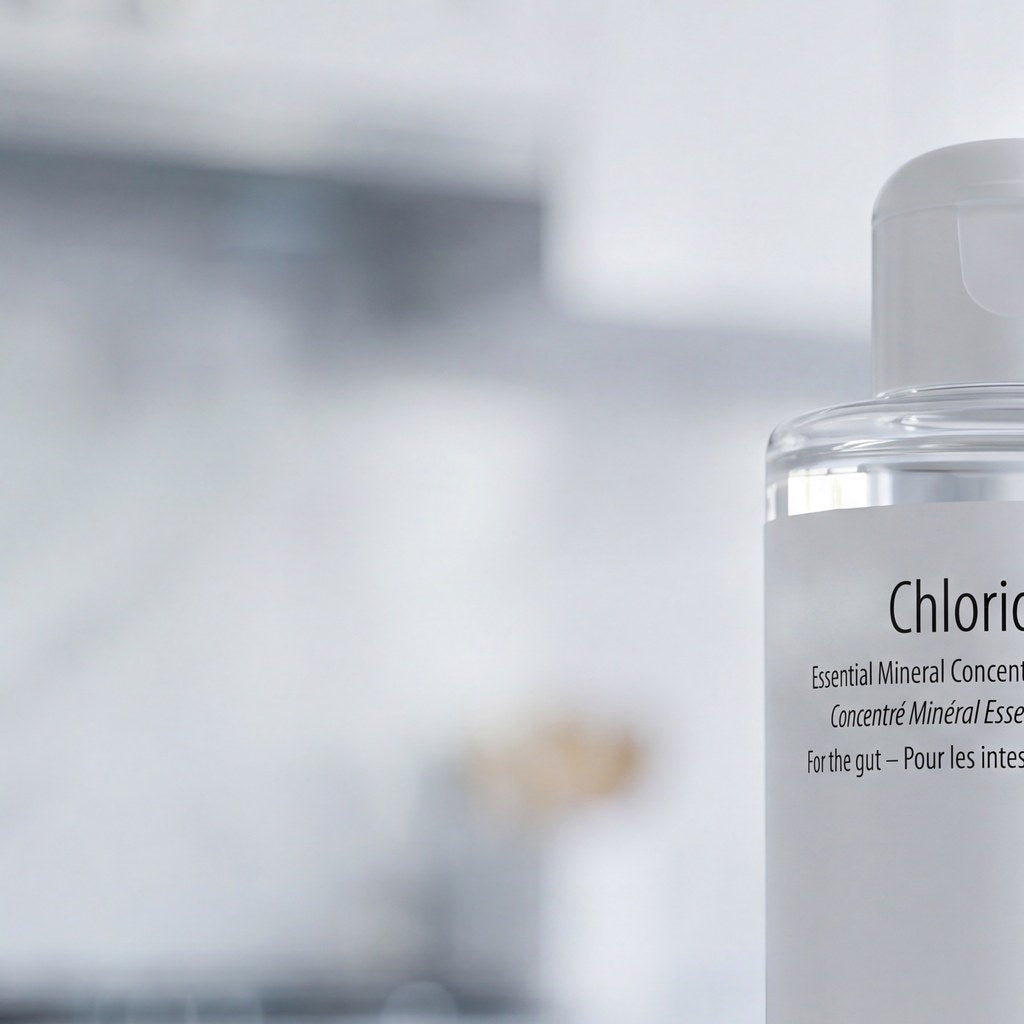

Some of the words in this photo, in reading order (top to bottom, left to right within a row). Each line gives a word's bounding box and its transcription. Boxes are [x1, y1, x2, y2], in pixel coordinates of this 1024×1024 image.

[812, 660, 873, 690] Essential
[877, 657, 945, 685] Mineral
[830, 700, 906, 728] Concentré
[908, 698, 981, 726] Minéral
[807, 750, 826, 774] For
[828, 748, 852, 773] the
[855, 749, 882, 778] gut
[903, 746, 945, 771] Pour
[949, 744, 976, 770] les
